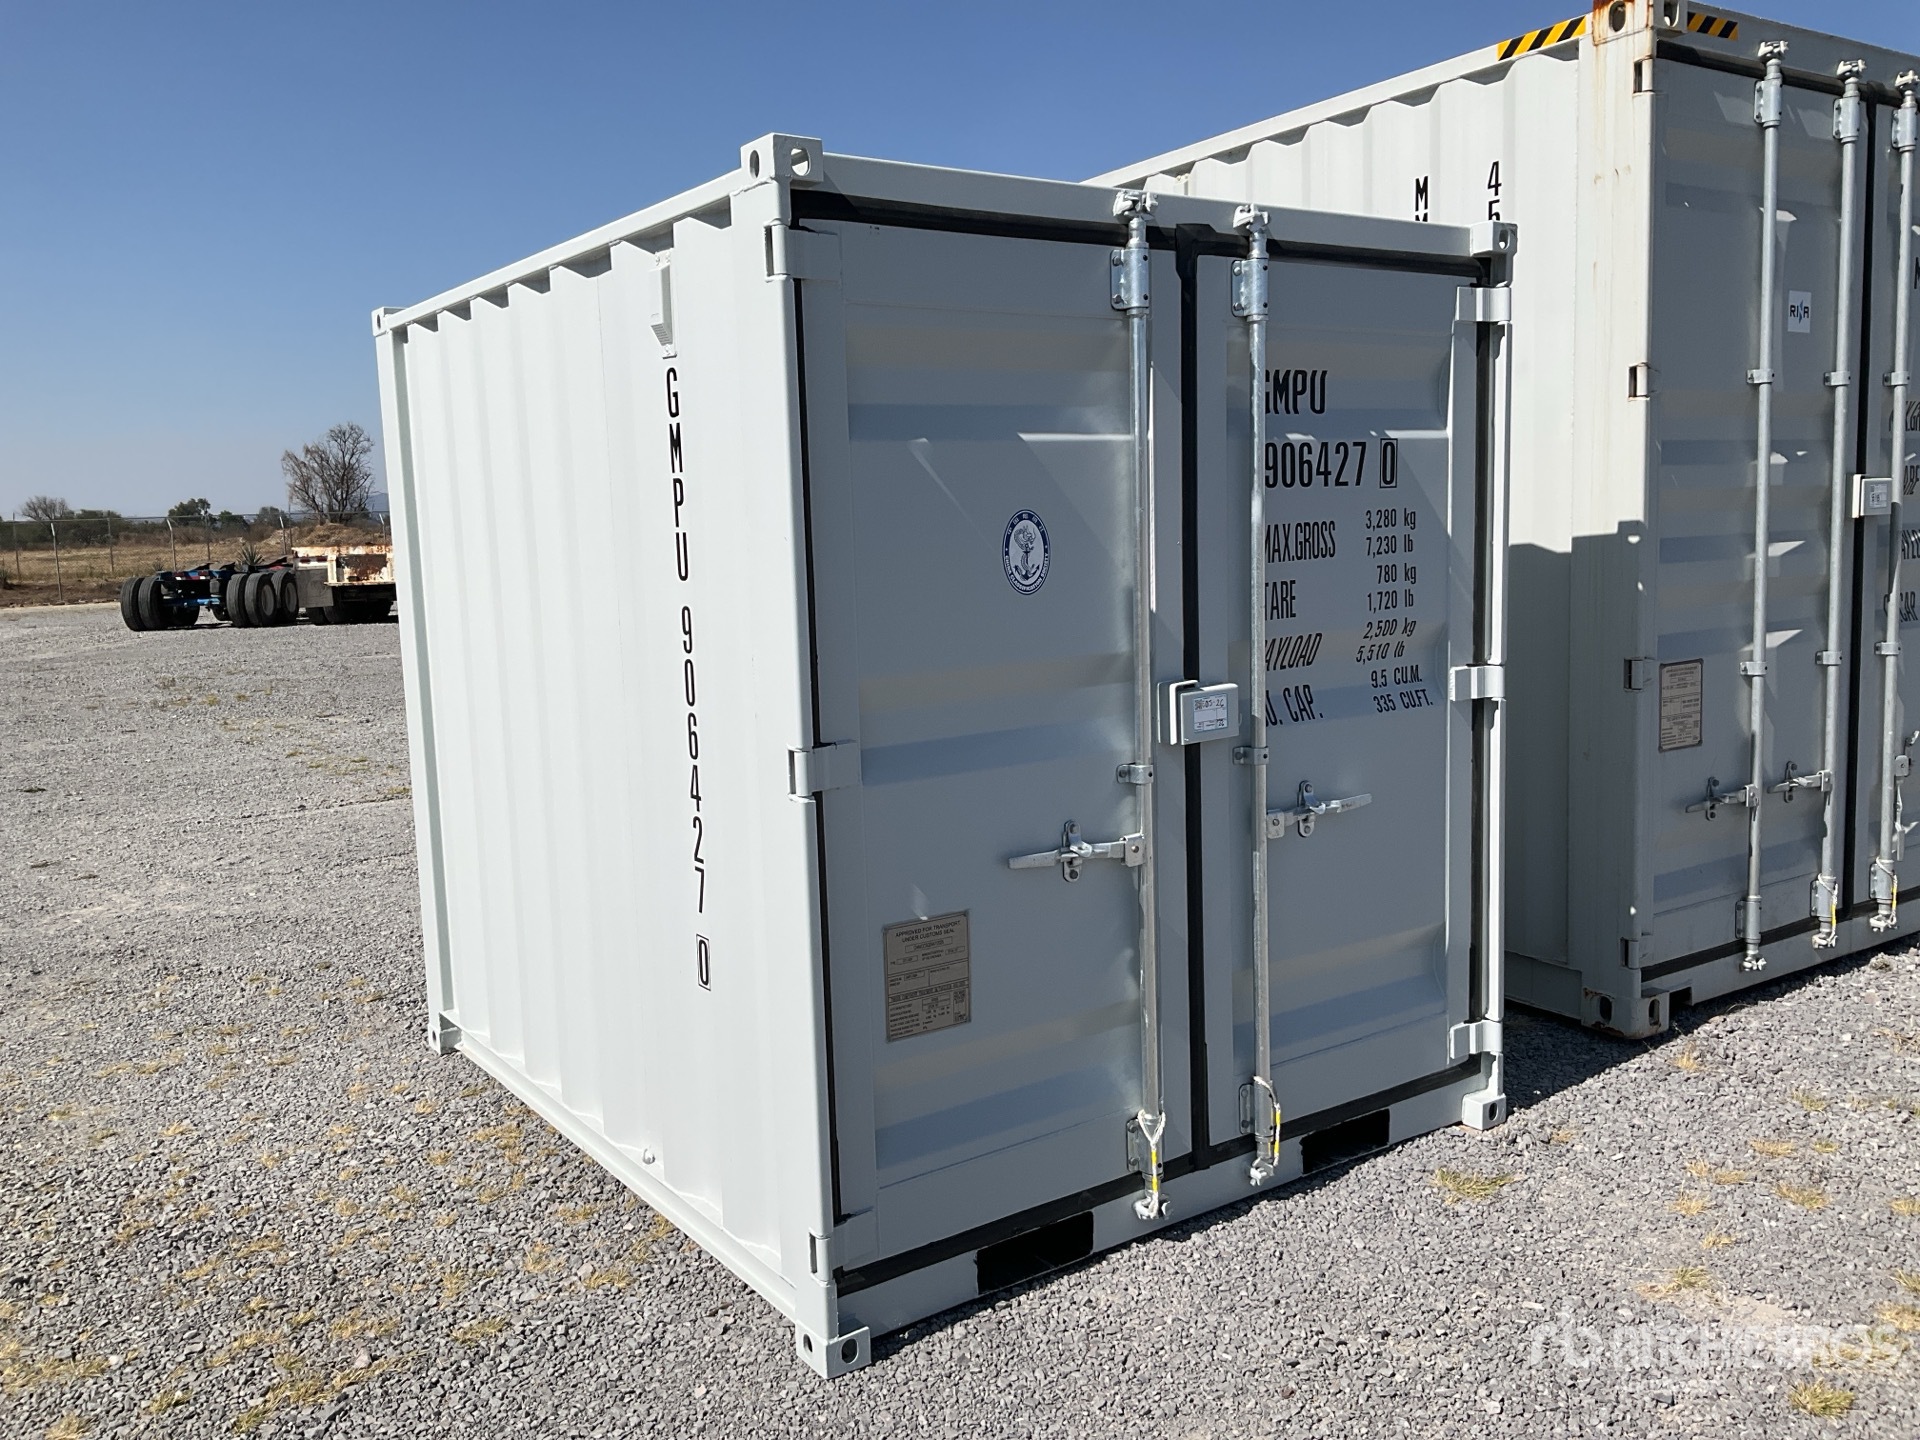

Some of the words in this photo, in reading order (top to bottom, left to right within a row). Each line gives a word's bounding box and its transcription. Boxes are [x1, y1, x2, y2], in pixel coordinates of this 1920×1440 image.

[1265, 440, 1367, 489] 906427
[1365, 508, 1397, 531] 3,280
[1403, 507, 1417, 531] kg
[1365, 534, 1397, 558] 7,230
[1403, 533, 1414, 553] lb
[1376, 563, 1398, 585] 780
[1403, 562, 1417, 585] kg
[1367, 589, 1398, 614] 1,720
[1403, 588, 1415, 608] lb
[666, 367, 688, 582] GMPU
[681, 605, 706, 914] 906427
[1363, 618, 1398, 641] 2,500
[1401, 616, 1417, 637] kg
[1265, 632, 1323, 672] AYLOAD
[1355, 640, 1390, 665] 5,510
[1392, 640, 1406, 659] lb
[1370, 668, 1388, 690] 9.5
[1283, 684, 1324, 723] CAP.
[1373, 692, 1396, 714] 335
